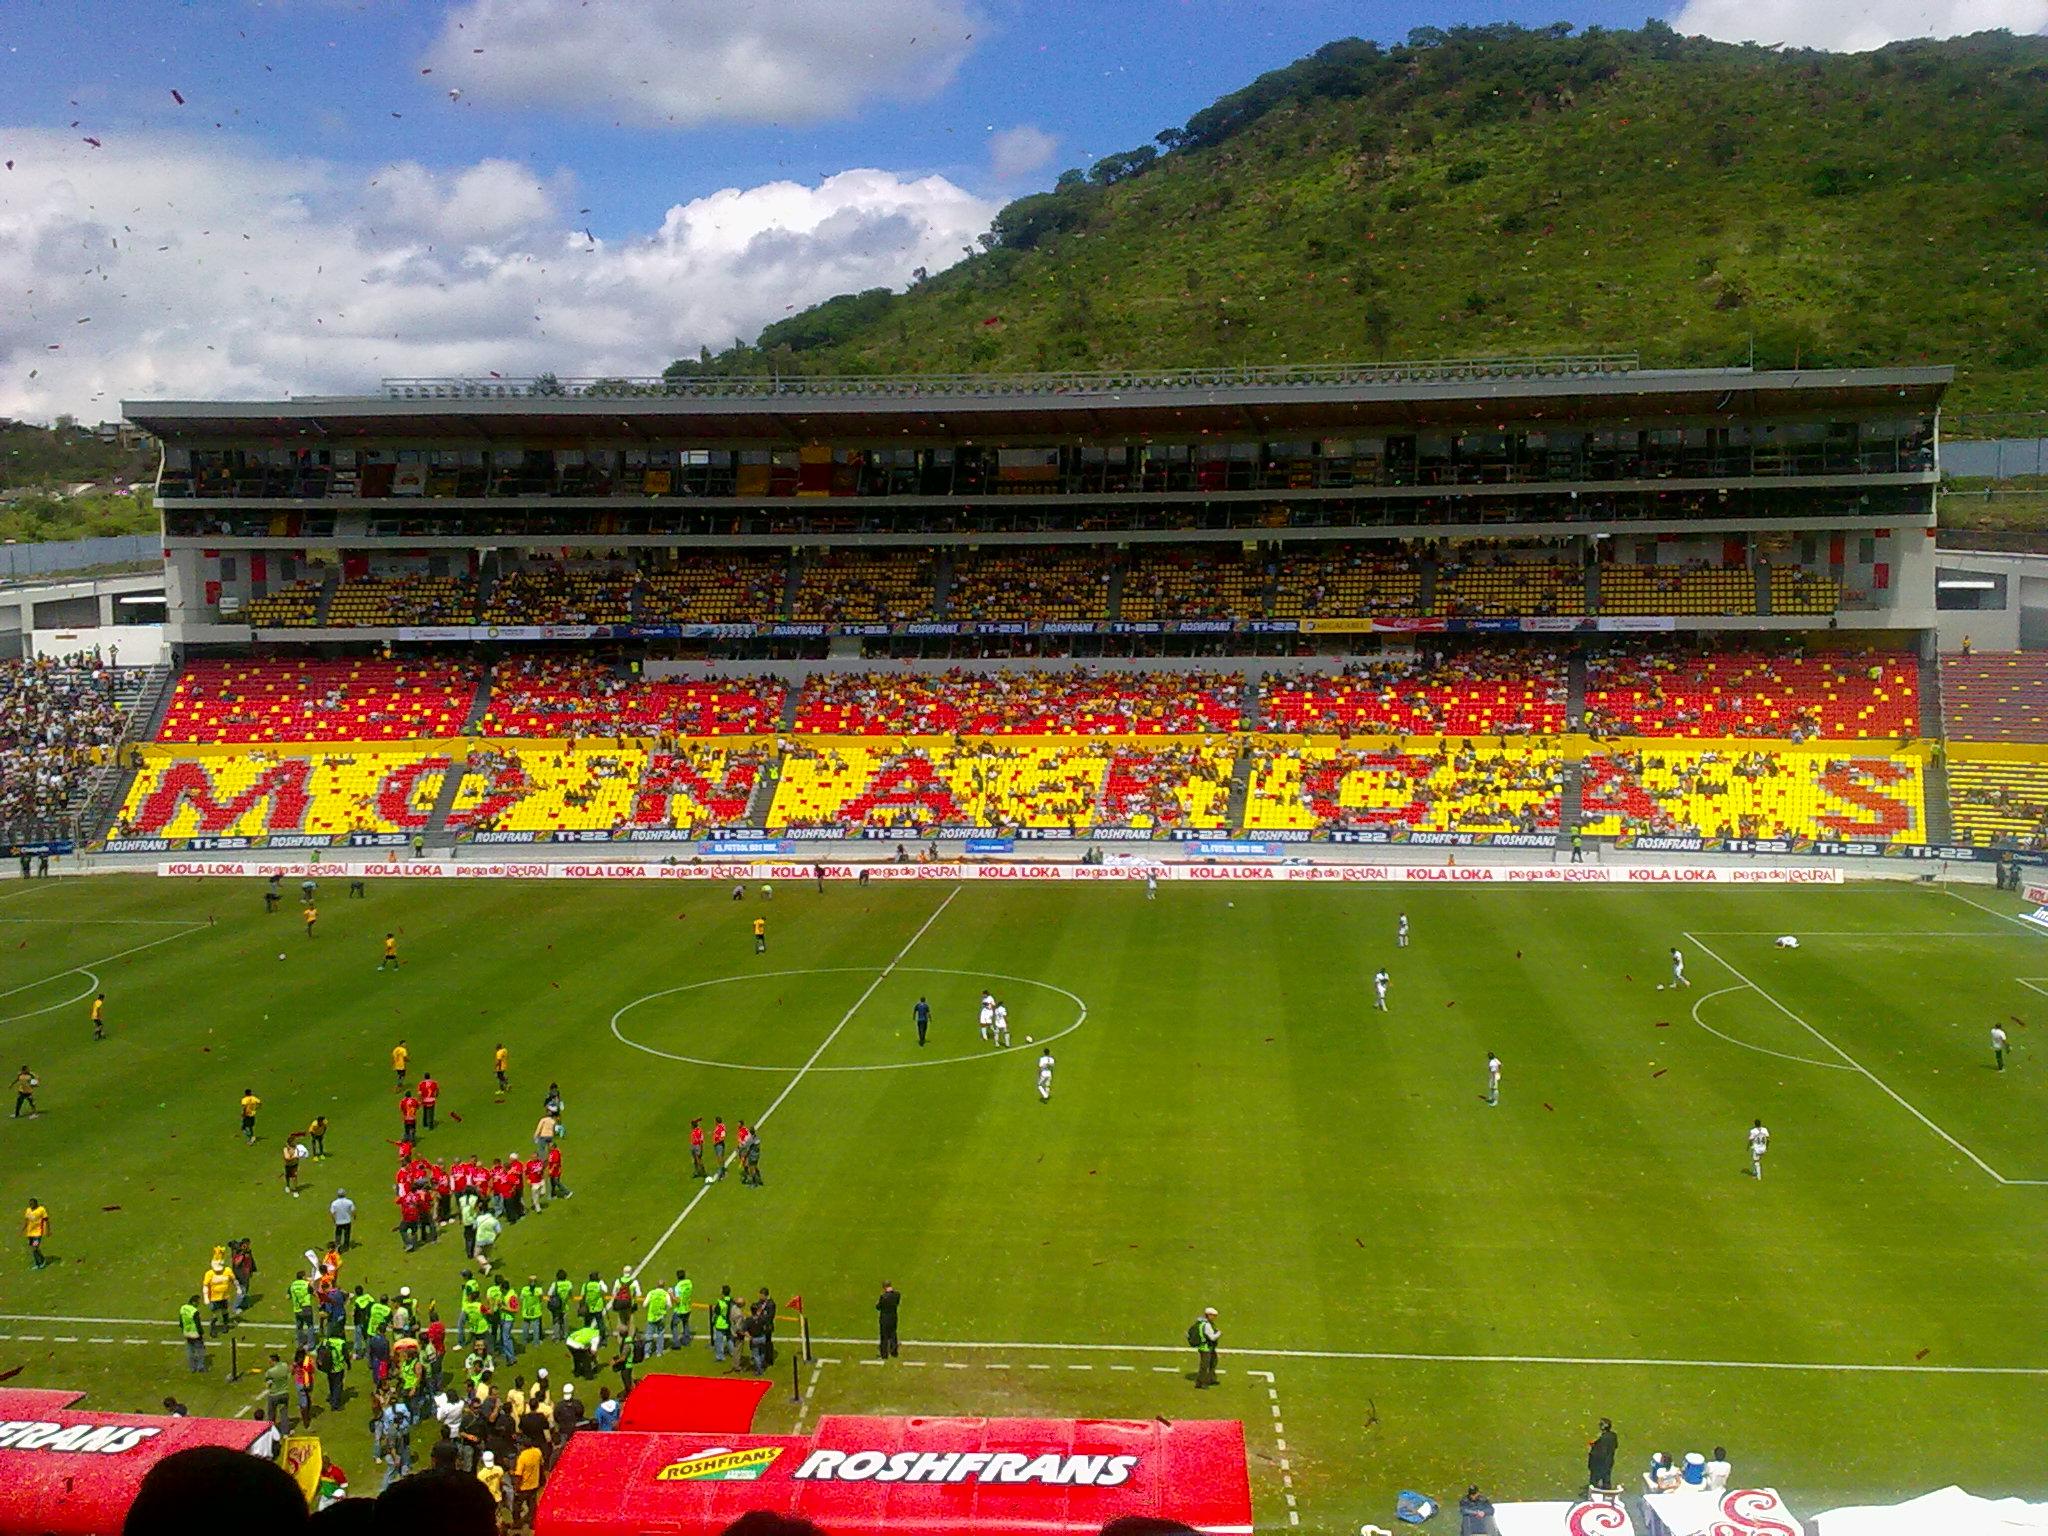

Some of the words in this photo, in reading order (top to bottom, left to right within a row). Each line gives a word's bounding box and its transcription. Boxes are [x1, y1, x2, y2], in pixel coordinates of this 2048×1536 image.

[475, 831, 534, 842] ROSHFRANS
[630, 830, 690, 841] ROSHFRANS
[787, 828, 843, 839] ROSHFRANS
[939, 828, 998, 839] ROSHFRANS
[1093, 828, 1151, 840] ROSHFRANS
[1251, 830, 1310, 841] ROSHFRANS
[1411, 832, 1473, 845] ROSHFRNS
[106, 838, 169, 851] ROSHFRANS
[269, 835, 332, 848] ROSHFRANS
[1493, 833, 1556, 847] ROSHFRANS
[1637, 837, 1701, 850] ROSHFRANS
[168, 863, 204, 875] KOLA
[208, 864, 245, 875] LOKA
[364, 864, 401, 875] KOLA
[405, 864, 443, 875] LOKA
[565, 865, 604, 877] KOLA
[608, 865, 646, 877] LOKA
[771, 866, 809, 877] KOLA
[979, 867, 1018, 878] KOLA
[1022, 867, 1061, 878] LOKA
[1190, 868, 1229, 878] KOLA
[1234, 868, 1274, 879] LOKA
[1407, 869, 1447, 880] KOLA
[1452, 869, 1493, 880] LOKA
[1629, 869, 1671, 880] KOLA
[1675, 870, 1716, 880] LOKA
[667, 1448, 777, 1480] ROSHFRANS
[793, 1449, 1138, 1486] ROSHFRANS
